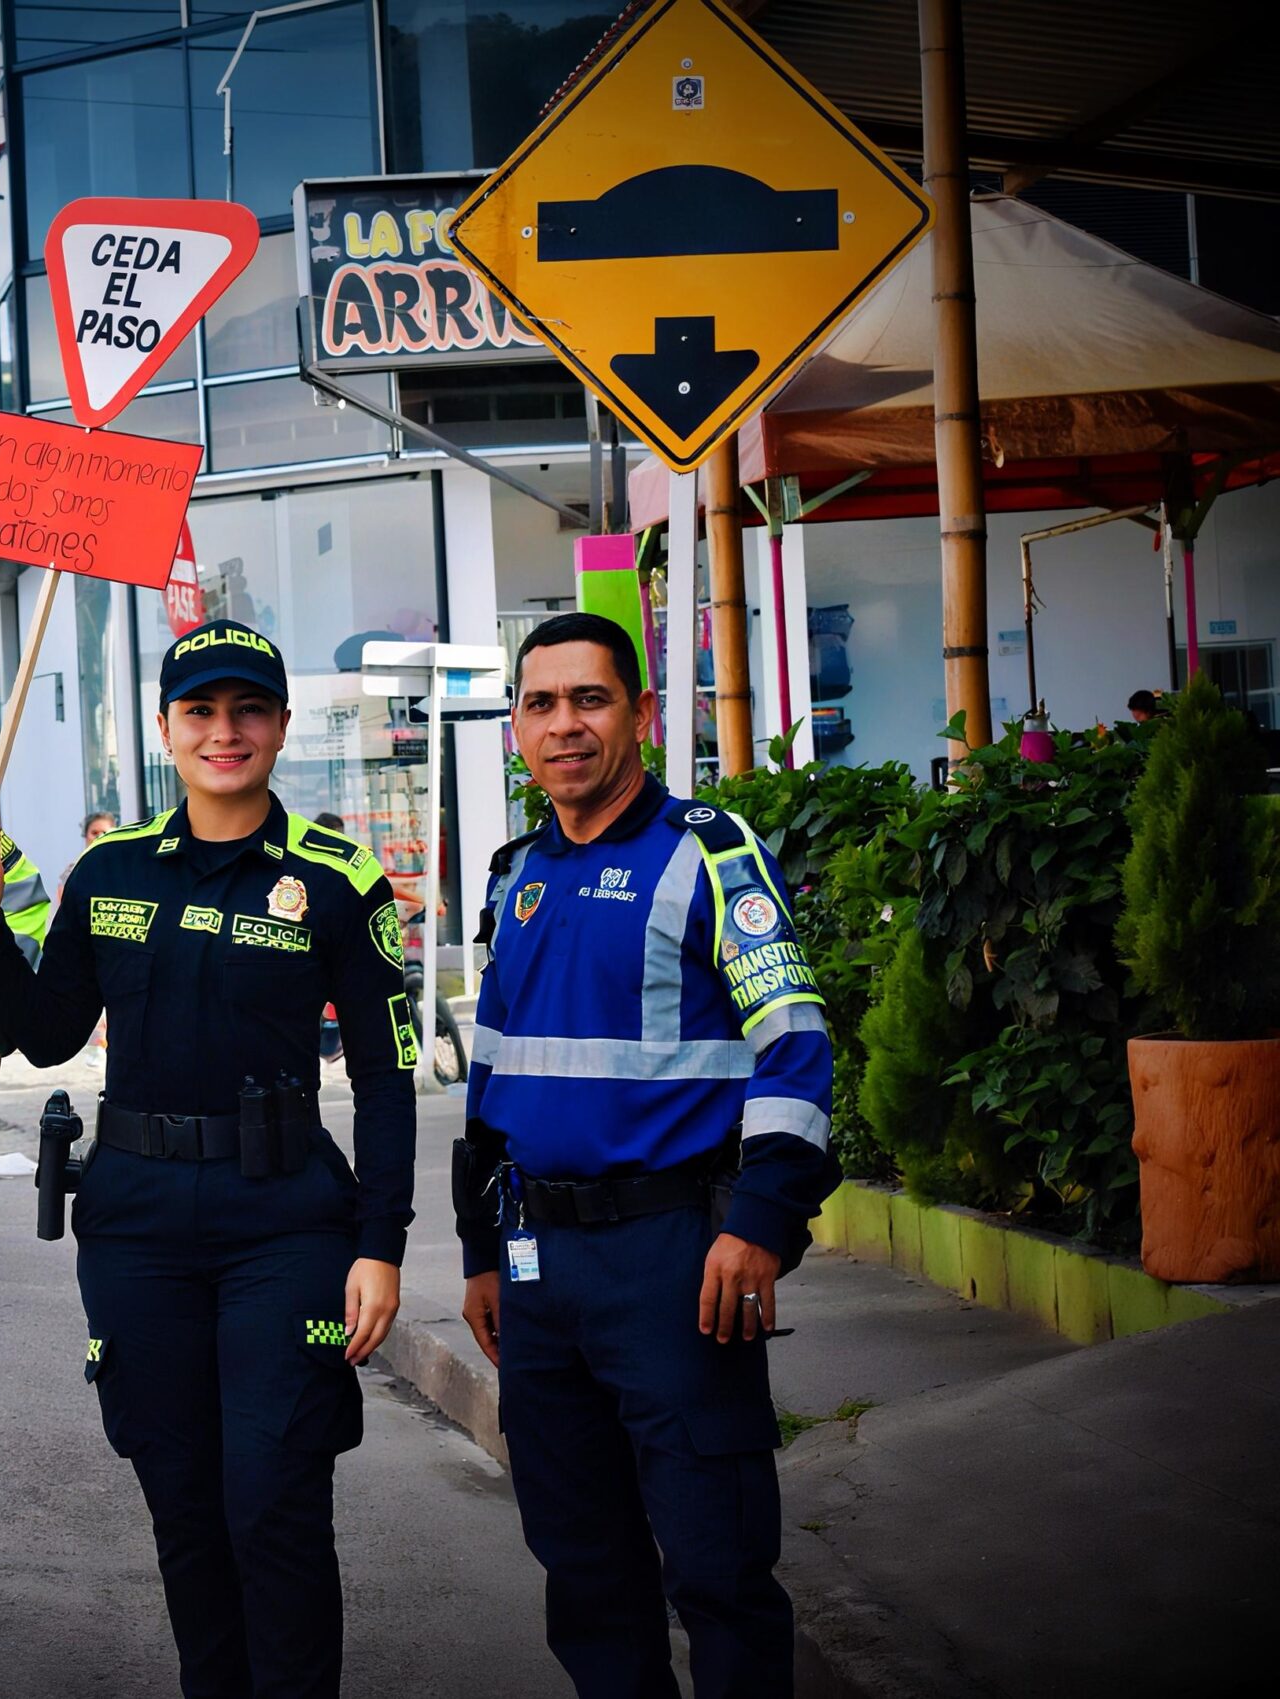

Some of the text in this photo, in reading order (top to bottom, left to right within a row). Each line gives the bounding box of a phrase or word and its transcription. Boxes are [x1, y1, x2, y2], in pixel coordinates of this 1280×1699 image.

[91, 234, 182, 274] CEDA
[344, 210, 403, 258] LA
[102, 272, 142, 308] EL
[76, 309, 161, 353] PASO
[174, 628, 276, 660] POLICIA
